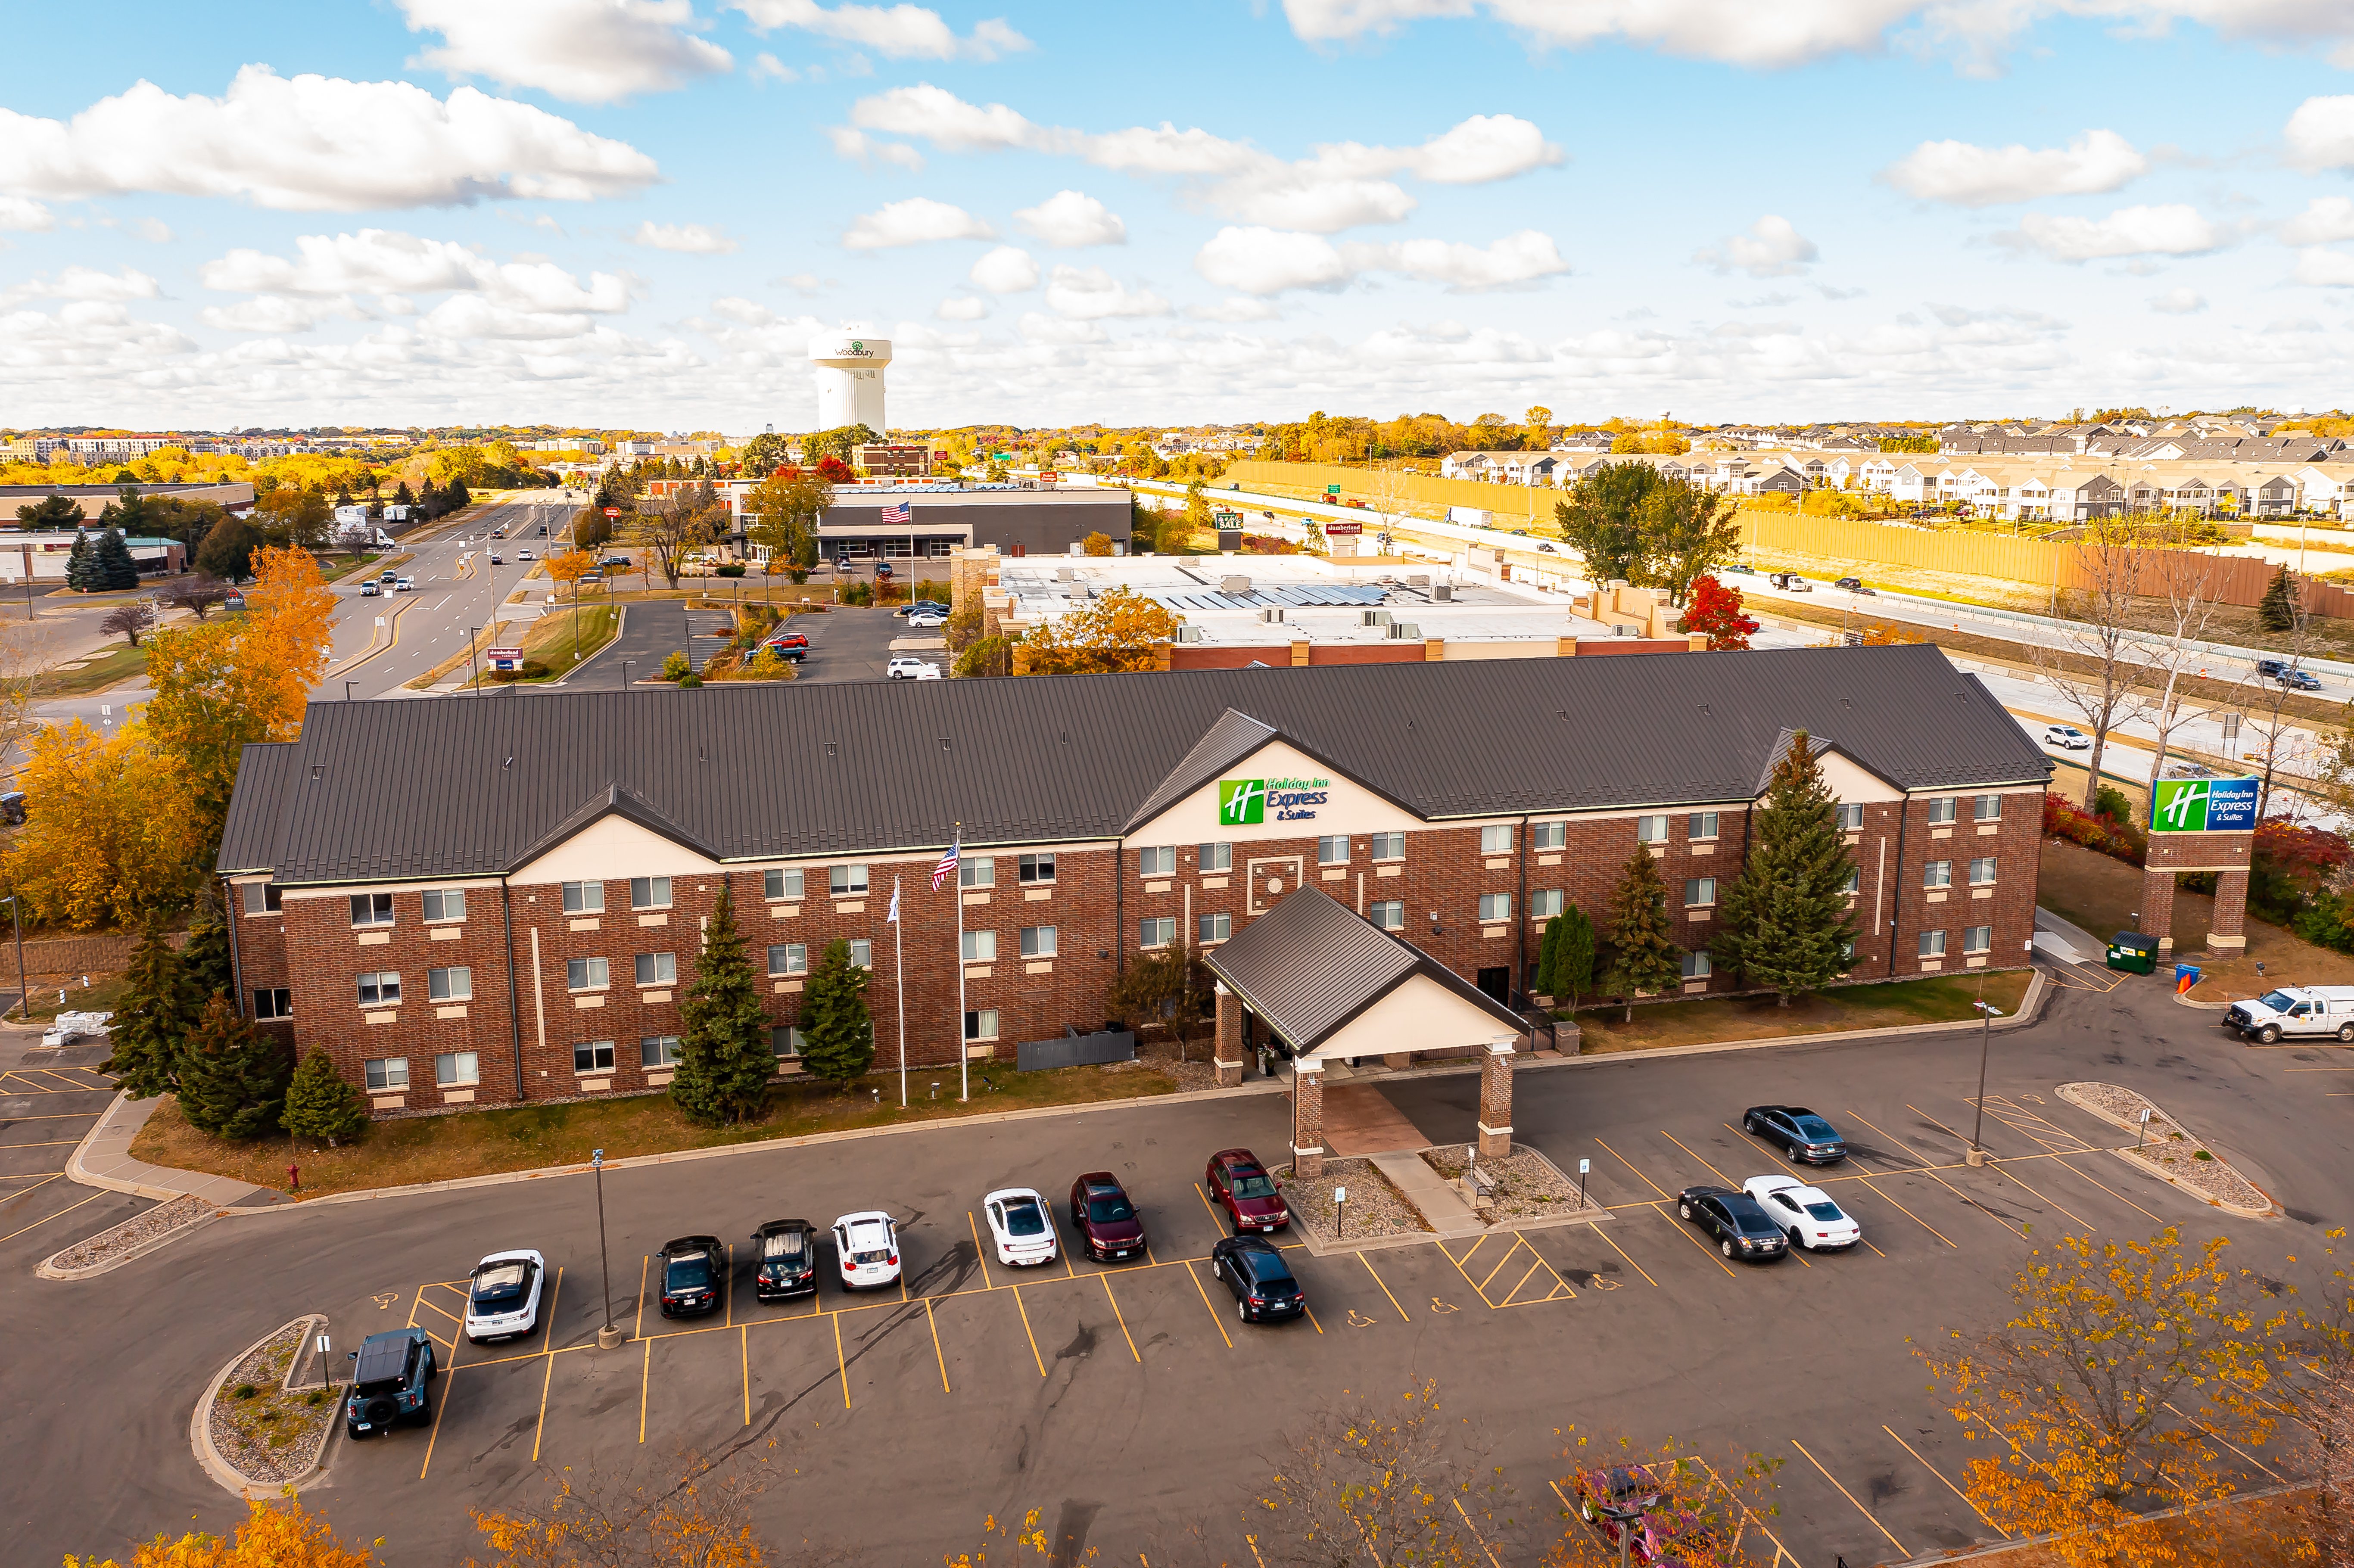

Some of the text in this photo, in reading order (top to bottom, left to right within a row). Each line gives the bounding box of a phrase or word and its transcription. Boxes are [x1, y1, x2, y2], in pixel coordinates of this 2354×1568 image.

[835, 346, 874, 358] Woodbury
[1266, 778, 1330, 791] Holiday Inn
[1266, 791, 1328, 810] Express
[2212, 790, 2254, 800] Holiday Inn
[2210, 800, 2254, 813] Express
[1277, 809, 1317, 820] & Suites
